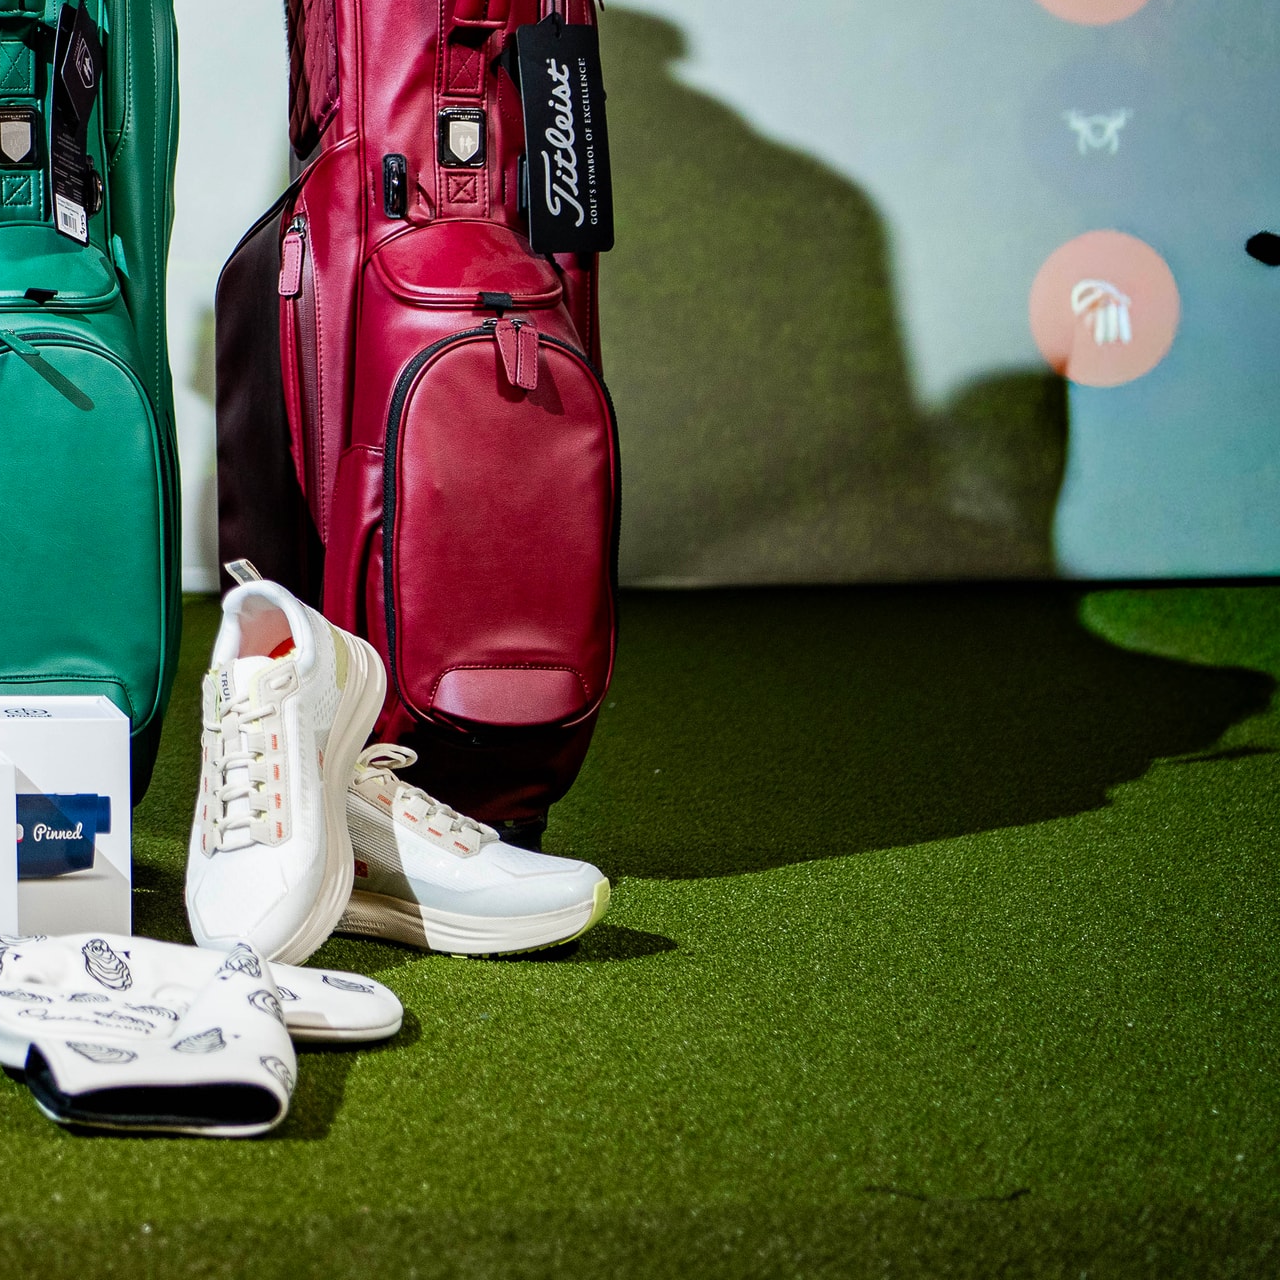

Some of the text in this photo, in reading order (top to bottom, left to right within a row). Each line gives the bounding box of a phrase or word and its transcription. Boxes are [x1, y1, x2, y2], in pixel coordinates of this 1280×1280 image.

[541, 58, 585, 228] Titleist
[585, 126, 594, 142] OF
[587, 146, 597, 186] SYMBOL
[589, 188, 599, 225] GOLF'S
[33, 823, 83, 841] Pinned
